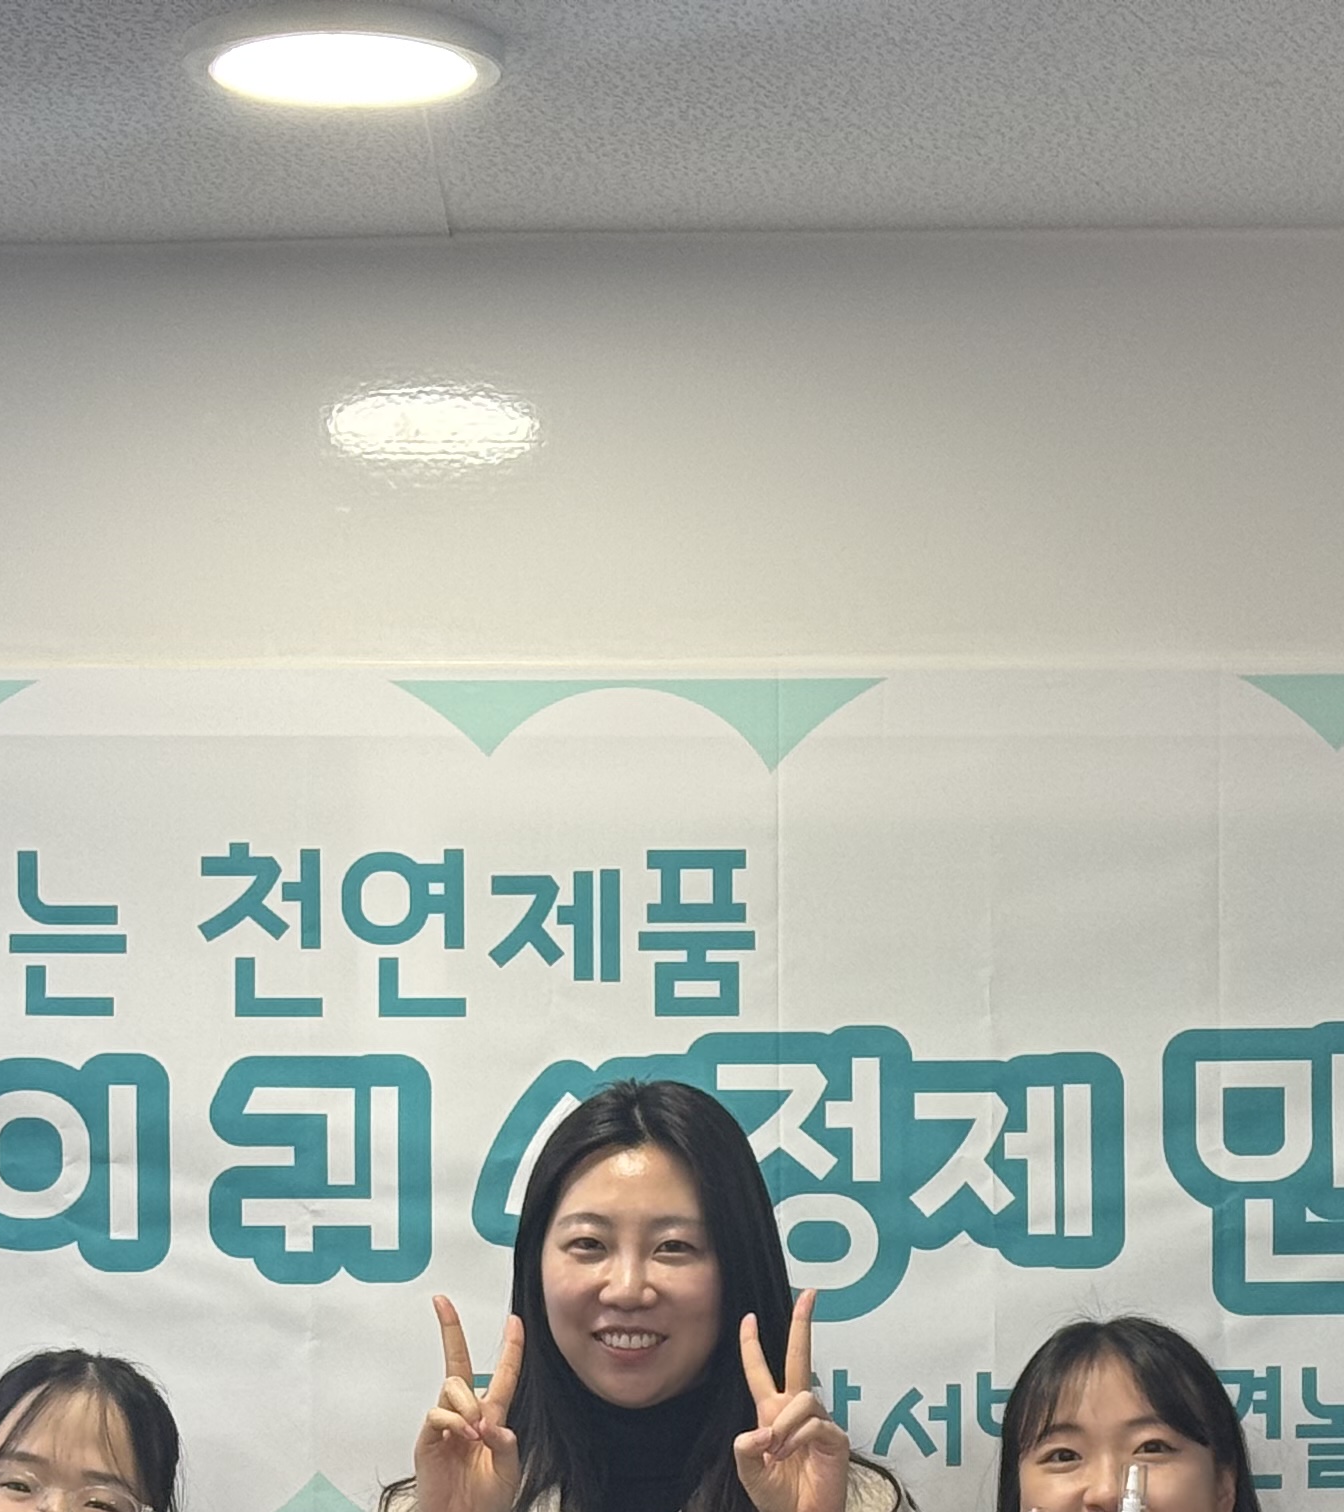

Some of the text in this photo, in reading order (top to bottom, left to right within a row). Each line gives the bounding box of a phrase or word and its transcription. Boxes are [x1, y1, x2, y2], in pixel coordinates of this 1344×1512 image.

[198, 842, 757, 1017] 천연제품
[488, 1042, 1108, 1306] 정제
[873, 1371, 1009, 1467] 서
